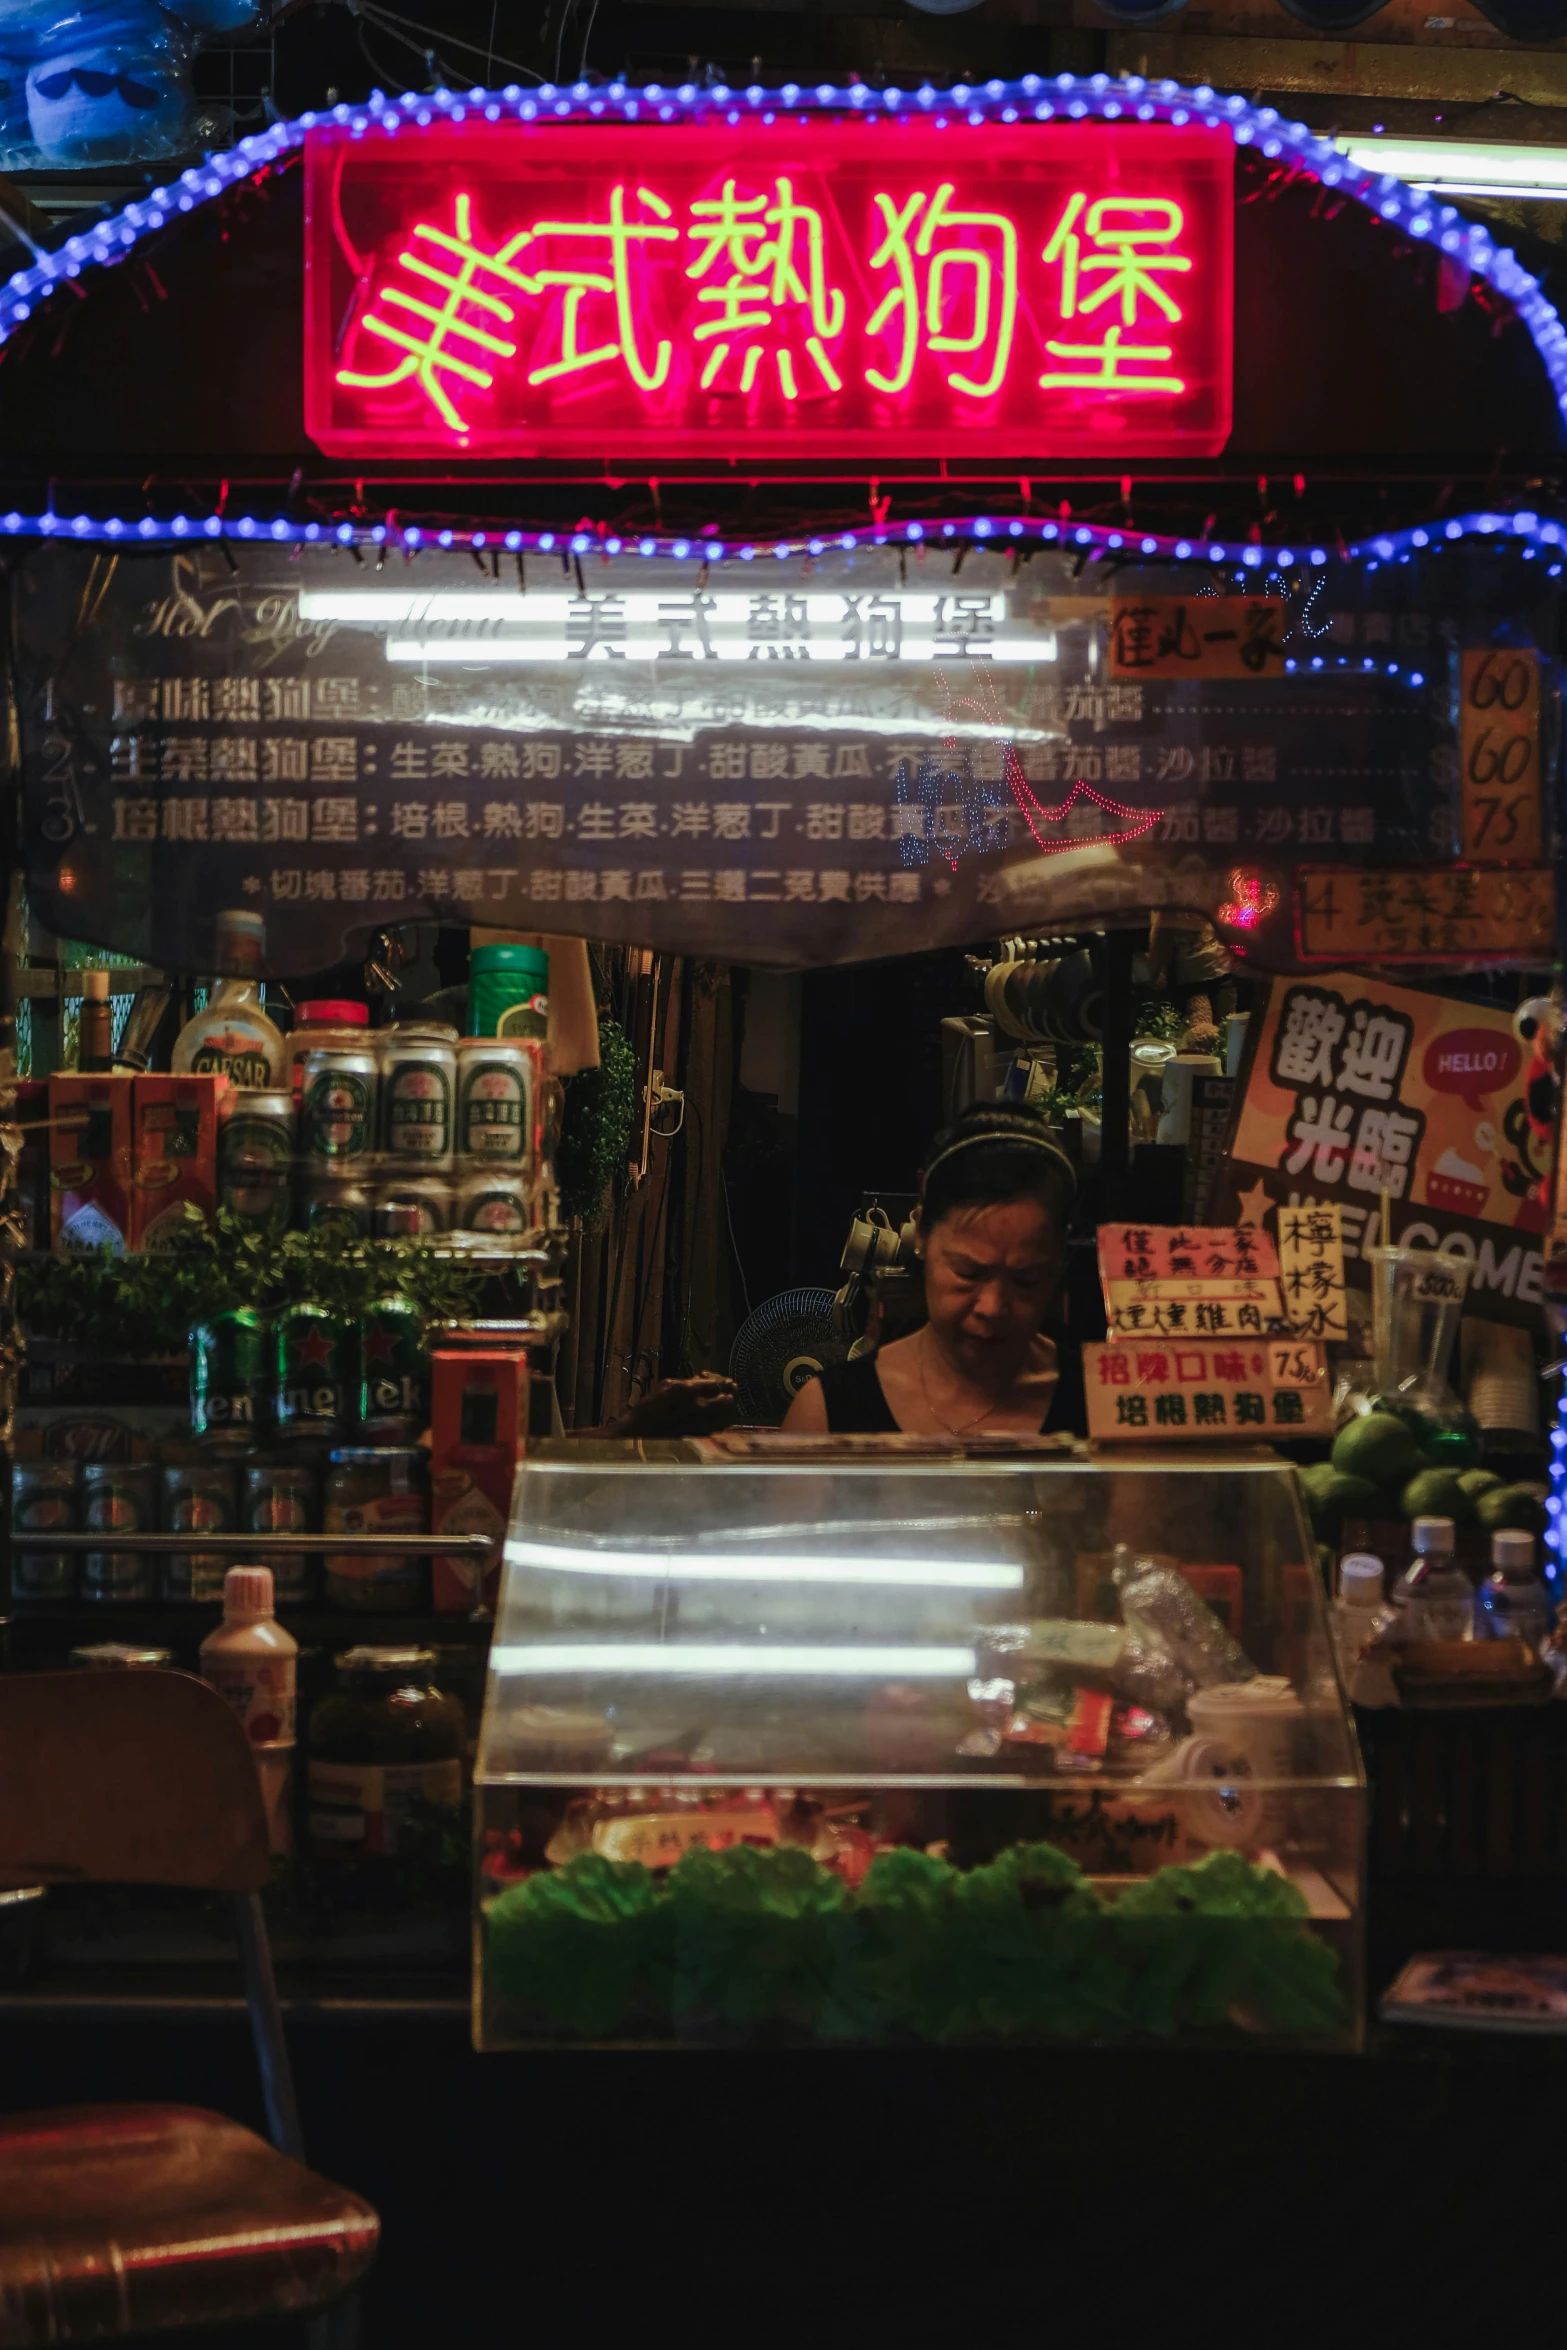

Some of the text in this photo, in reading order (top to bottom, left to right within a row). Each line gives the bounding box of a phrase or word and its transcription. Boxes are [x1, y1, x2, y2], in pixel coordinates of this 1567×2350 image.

[336, 176, 1193, 431] 美式熱狗堡
[132, 588, 504, 657] Hot Dog Menu
[565, 595, 996, 660] 美式熱狗堡
[1469, 652, 1531, 711] 60
[1468, 726, 1532, 785] 60
[1471, 795, 1532, 850] 75
[1275, 994, 1407, 1101] 歡迎
[1285, 1096, 1420, 1199] 光臨
[1122, 1222, 1261, 1255] 僅此一家
[1290, 1192, 1546, 1304] ELCOME
[1283, 1211, 1346, 1337] 檸檬冰
[1097, 1351, 1249, 1386] 招牌口味
[1116, 1390, 1306, 1428] 培根熱狗堡
